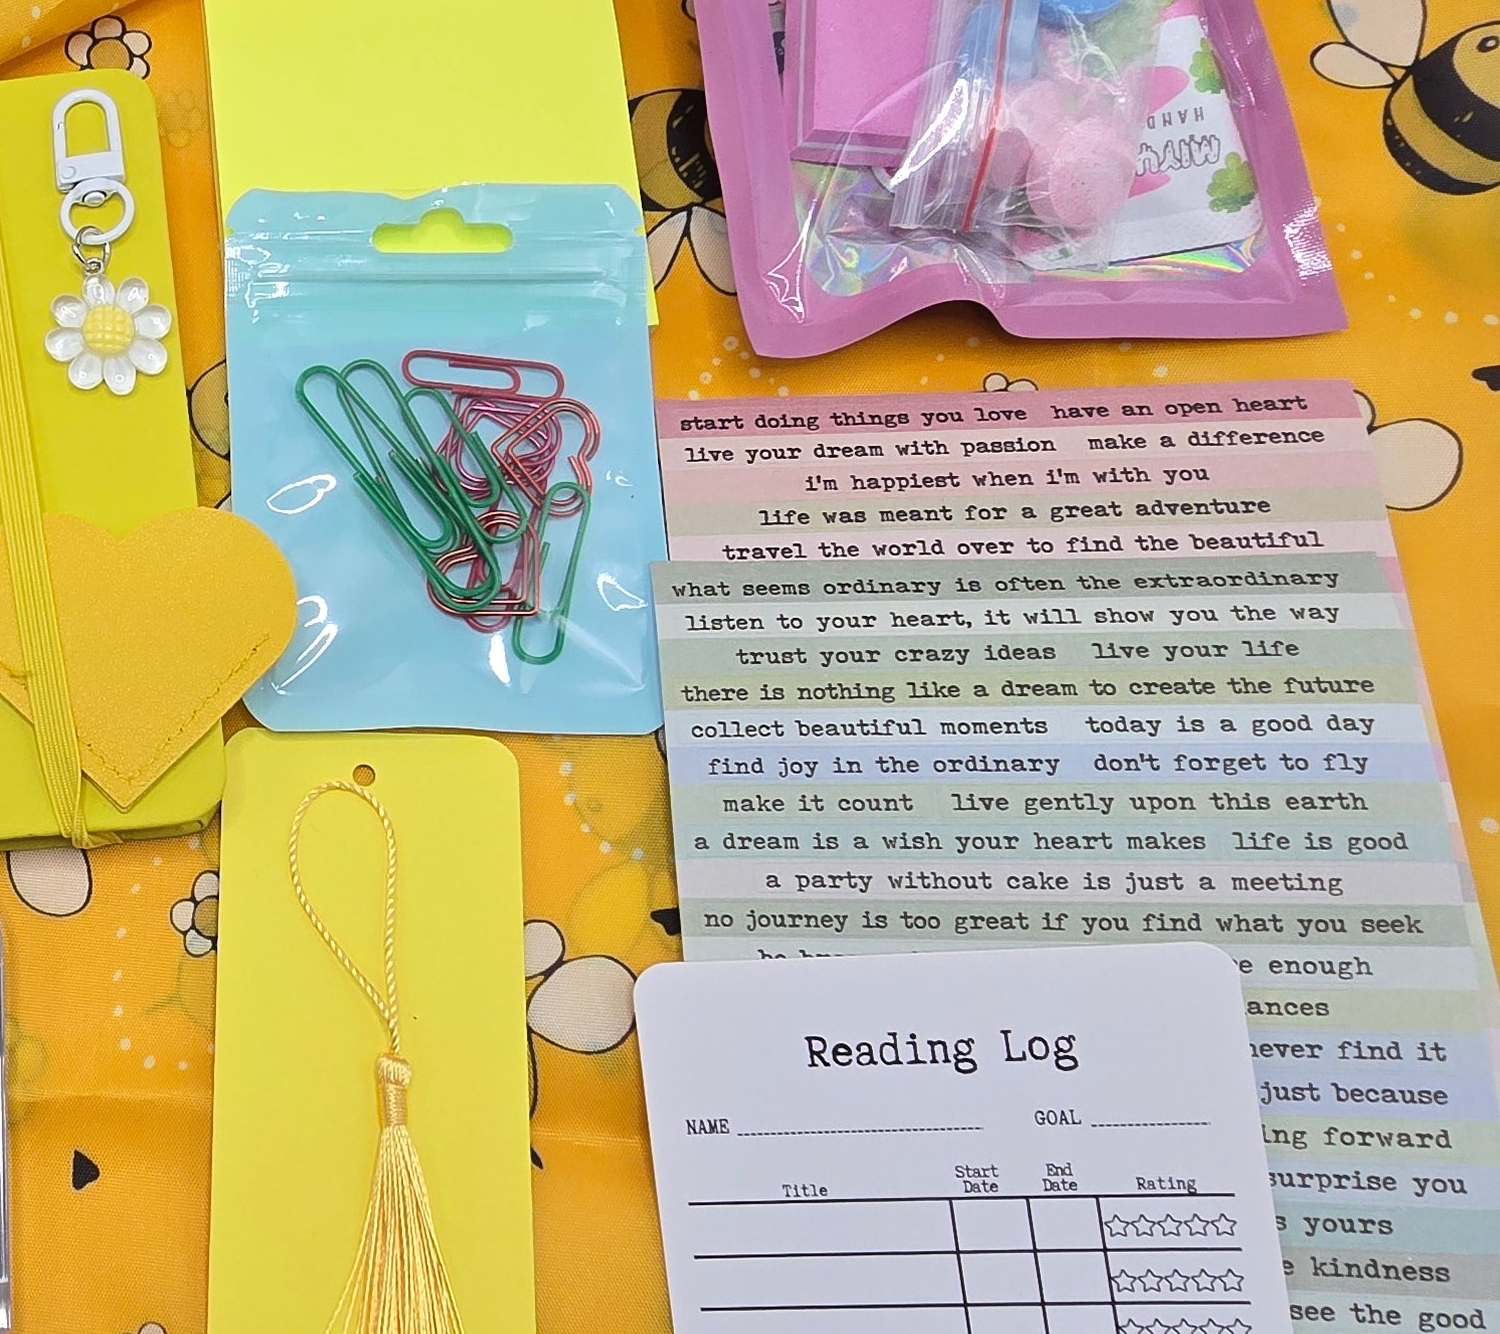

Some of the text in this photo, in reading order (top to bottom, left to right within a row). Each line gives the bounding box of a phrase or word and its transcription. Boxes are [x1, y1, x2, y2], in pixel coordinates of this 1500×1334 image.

[1146, 106, 1205, 130] HAND
[1050, 396, 1307, 419] have an open heart
[681, 408, 1027, 431] start doing things you love
[685, 437, 1057, 464] live your dream with passion
[1087, 431, 1325, 450] make difference
[805, 467, 1210, 492] i'm happiest when i'm with you
[759, 498, 1271, 525] life was meant for great adventure
[722, 531, 1324, 560] travel the world over to find the beautiful
[672, 572, 1338, 597] what seems ordinary is often the extraordinary
[685, 605, 1339, 632] listen to your heart, it will show you the way
[736, 644, 1056, 667] trust your crazy ideas
[1092, 640, 1299, 661] live your life
[681, 677, 1374, 703] there is nothing like dream to create the future
[692, 717, 1048, 738] collect beautiful moments
[1085, 714, 1375, 737] today is good day
[708, 755, 1060, 778] find joy in the ordinary
[1094, 753, 1368, 775] don't forget to fly
[723, 794, 913, 812] make it count
[951, 792, 1368, 815] live gently upon this earth
[723, 832, 1206, 854] dream is wish your heart makes
[1232, 832, 1408, 855] life is good
[795, 871, 1343, 896] party without cake is just meeting
[704, 910, 1424, 937] no journey is too great if you find what you seek
[1269, 957, 1373, 980] enough
[804, 1030, 1079, 1074] Reading Log
[1338, 1041, 1446, 1061] find it
[1260, 1082, 1448, 1105] just because
[686, 1119, 730, 1135] NAME
[1034, 1109, 1082, 1126] GOAL
[1324, 1127, 1452, 1148] forward
[955, 1164, 999, 1178] Start
[1046, 1162, 1073, 1176] End
[782, 1184, 828, 1197] Title
[963, 1180, 999, 1193] Date
[1042, 1179, 1078, 1192] Date
[1136, 1177, 1197, 1194] Rating
[1412, 1178, 1467, 1197] you
[1303, 1217, 1393, 1236] yours
[1310, 1256, 1450, 1282] kindness
[1349, 1303, 1486, 1332] the good
